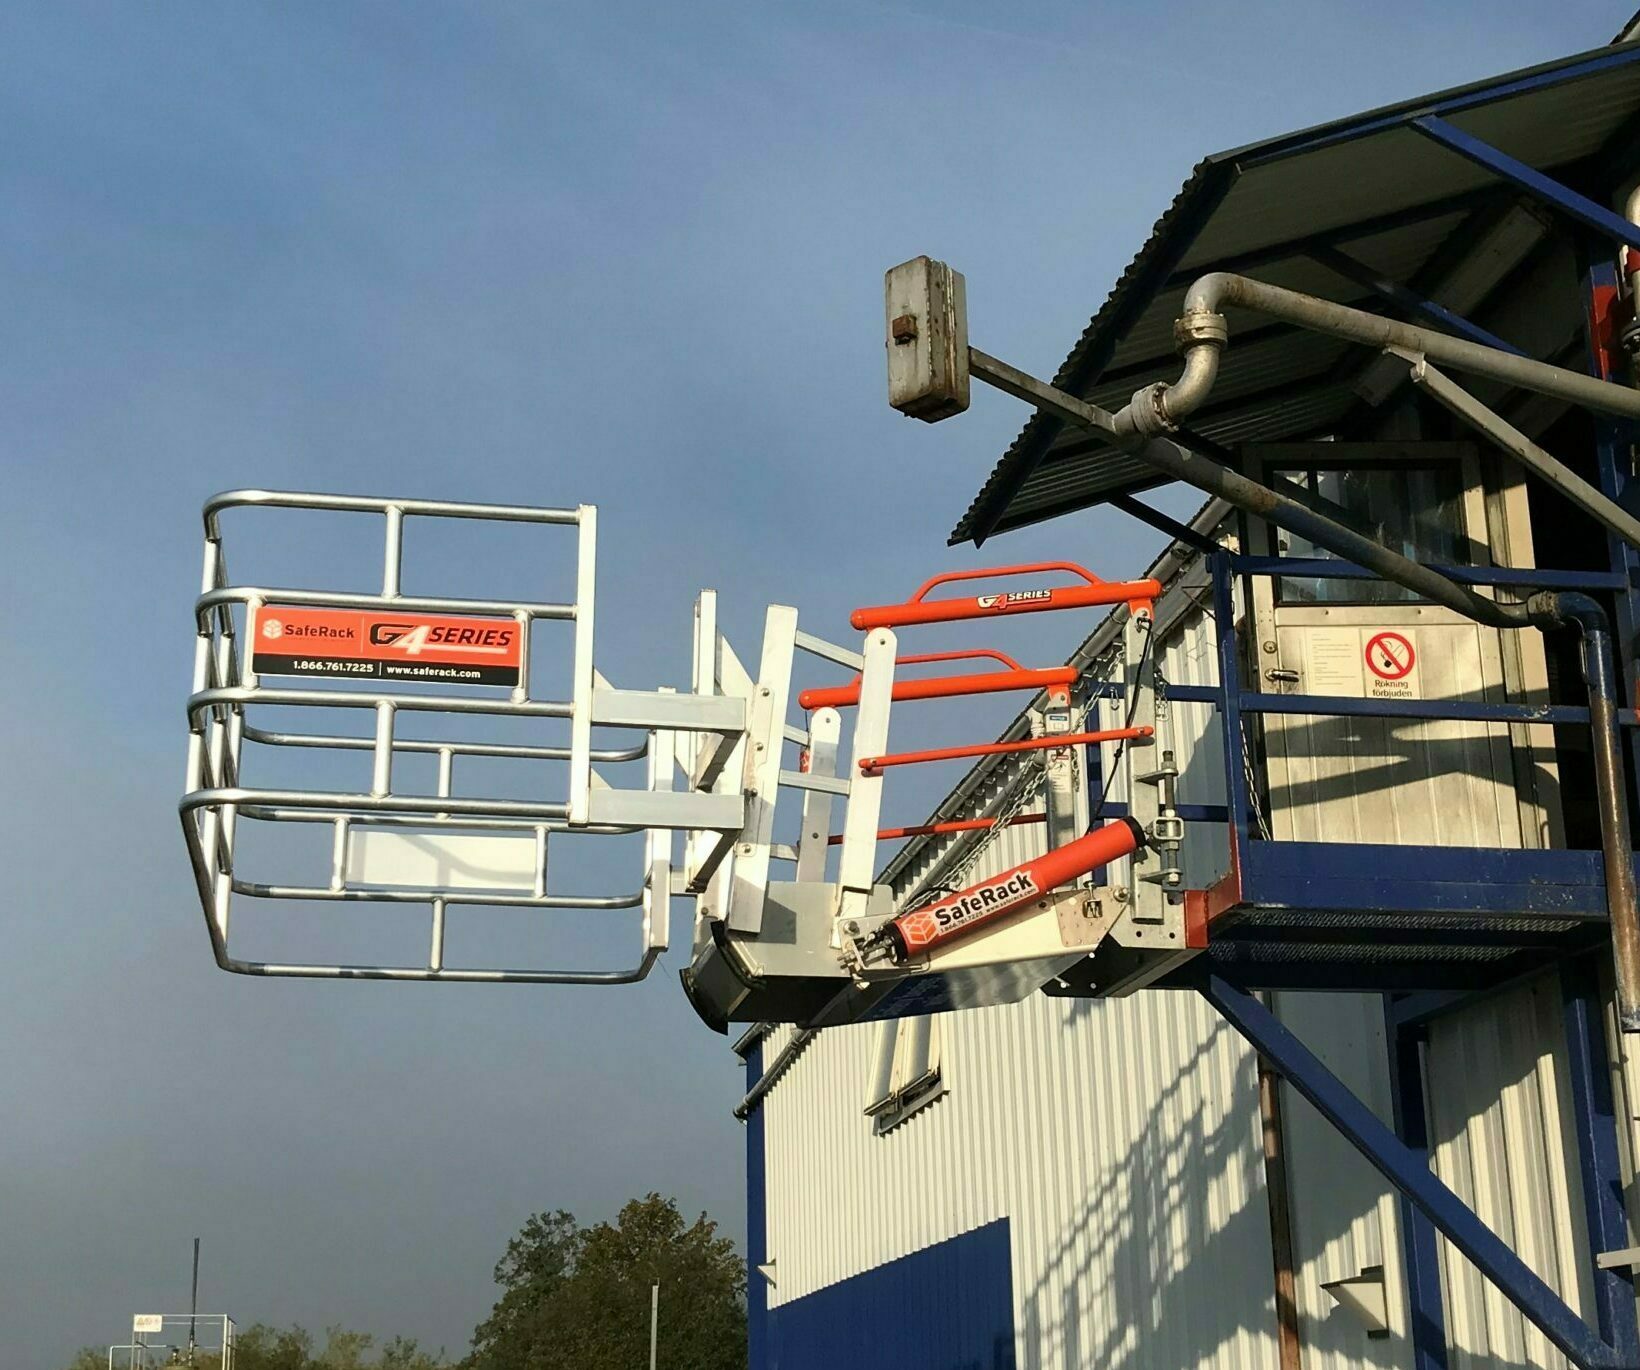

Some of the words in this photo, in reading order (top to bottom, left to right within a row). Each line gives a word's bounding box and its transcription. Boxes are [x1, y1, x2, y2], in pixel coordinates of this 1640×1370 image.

[977, 594, 1007, 609] G4
[1007, 589, 1051, 601] SERIES
[285, 624, 355, 638] SafeRack
[370, 623, 431, 655] G4
[428, 626, 514, 647] SERIES
[293, 660, 374, 673] 1.866.761.7225
[386, 665, 481, 678] www.saferack.com
[935, 874, 1032, 926] SafeRack
